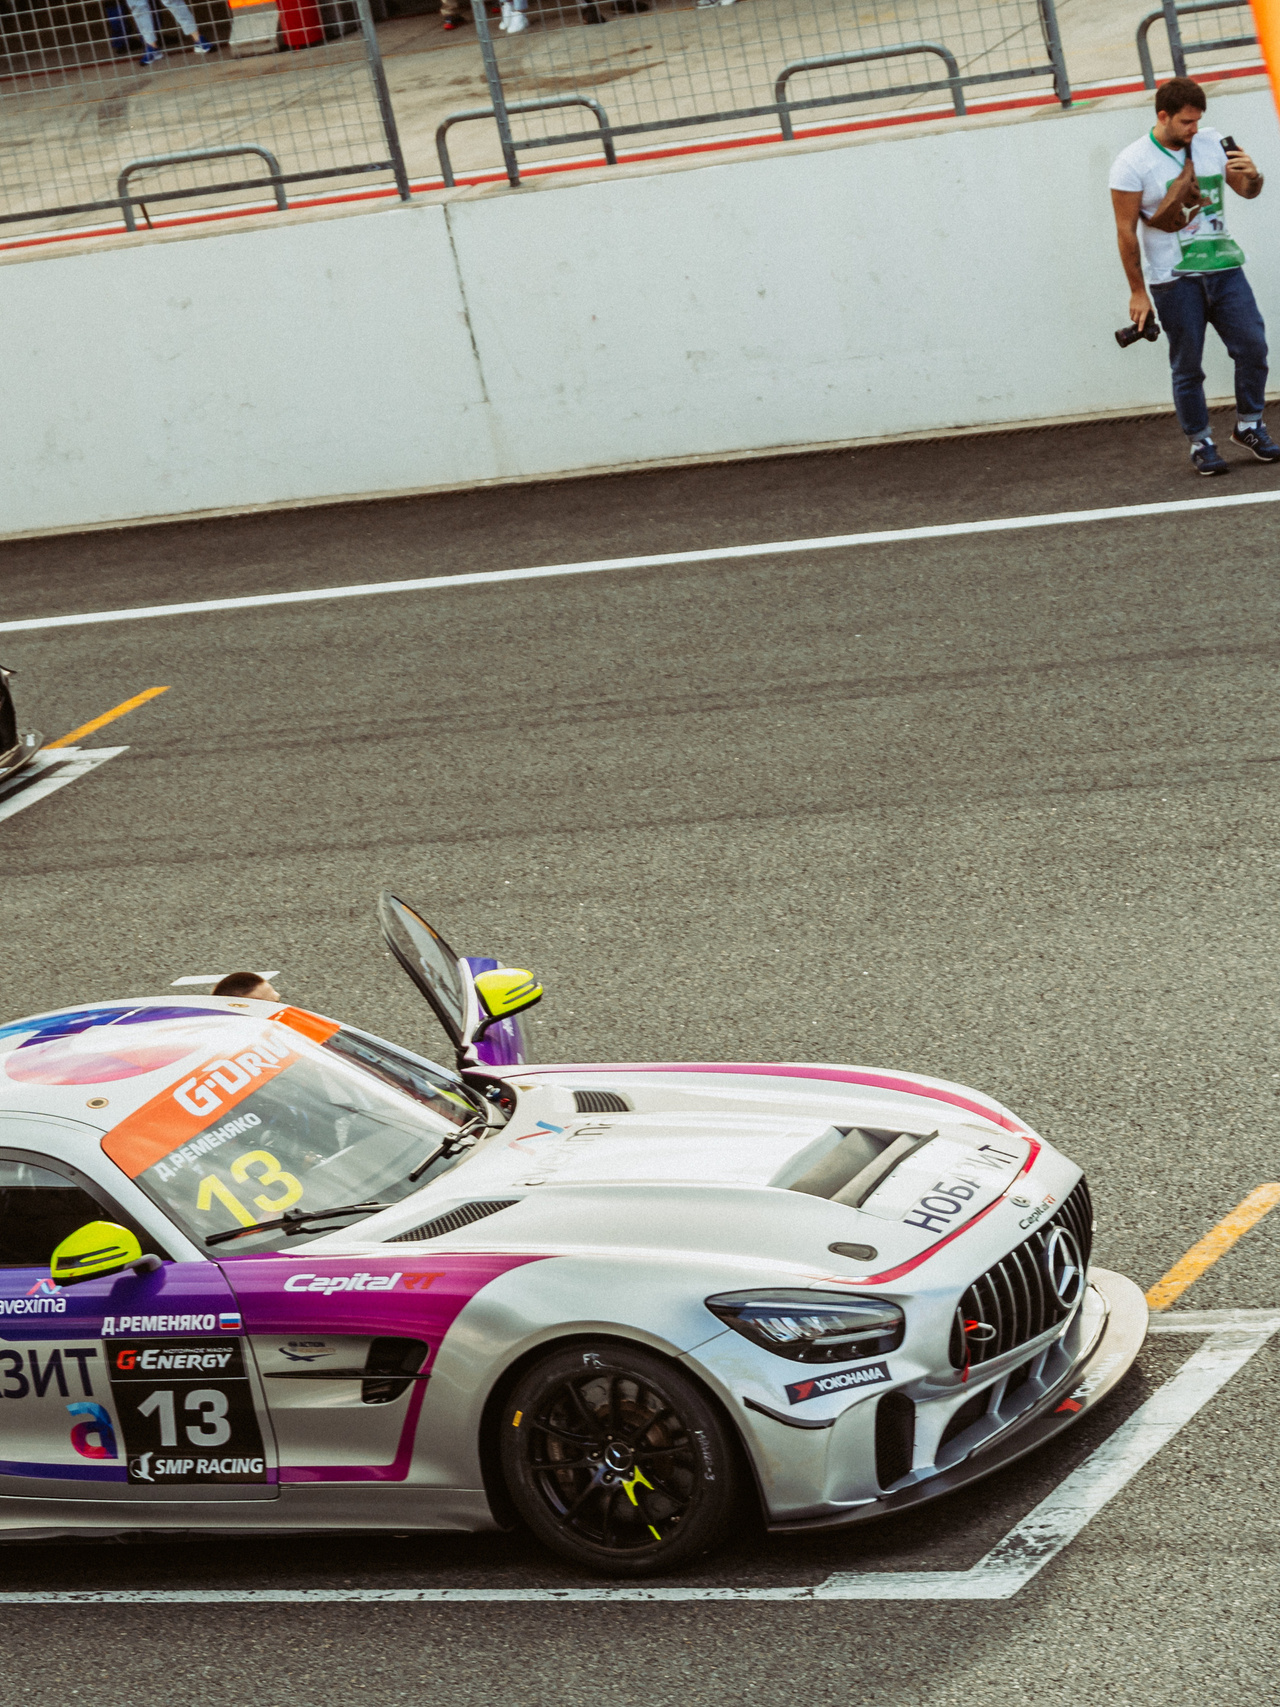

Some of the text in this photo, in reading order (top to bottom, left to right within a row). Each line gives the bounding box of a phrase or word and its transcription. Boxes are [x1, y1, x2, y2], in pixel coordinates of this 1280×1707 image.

[153, 1112, 262, 1182] Д.РЕМЕНЯКО
[196, 1149, 304, 1228] 13
[903, 1144, 1019, 1234] НОБАИТ
[101, 1314, 216, 1336] Д.РЕМЕНЯКО
[816, 1366, 885, 1392] YOKOHAMA
[137, 1389, 232, 1447] 13
[154, 1457, 264, 1475] SMP RACING
